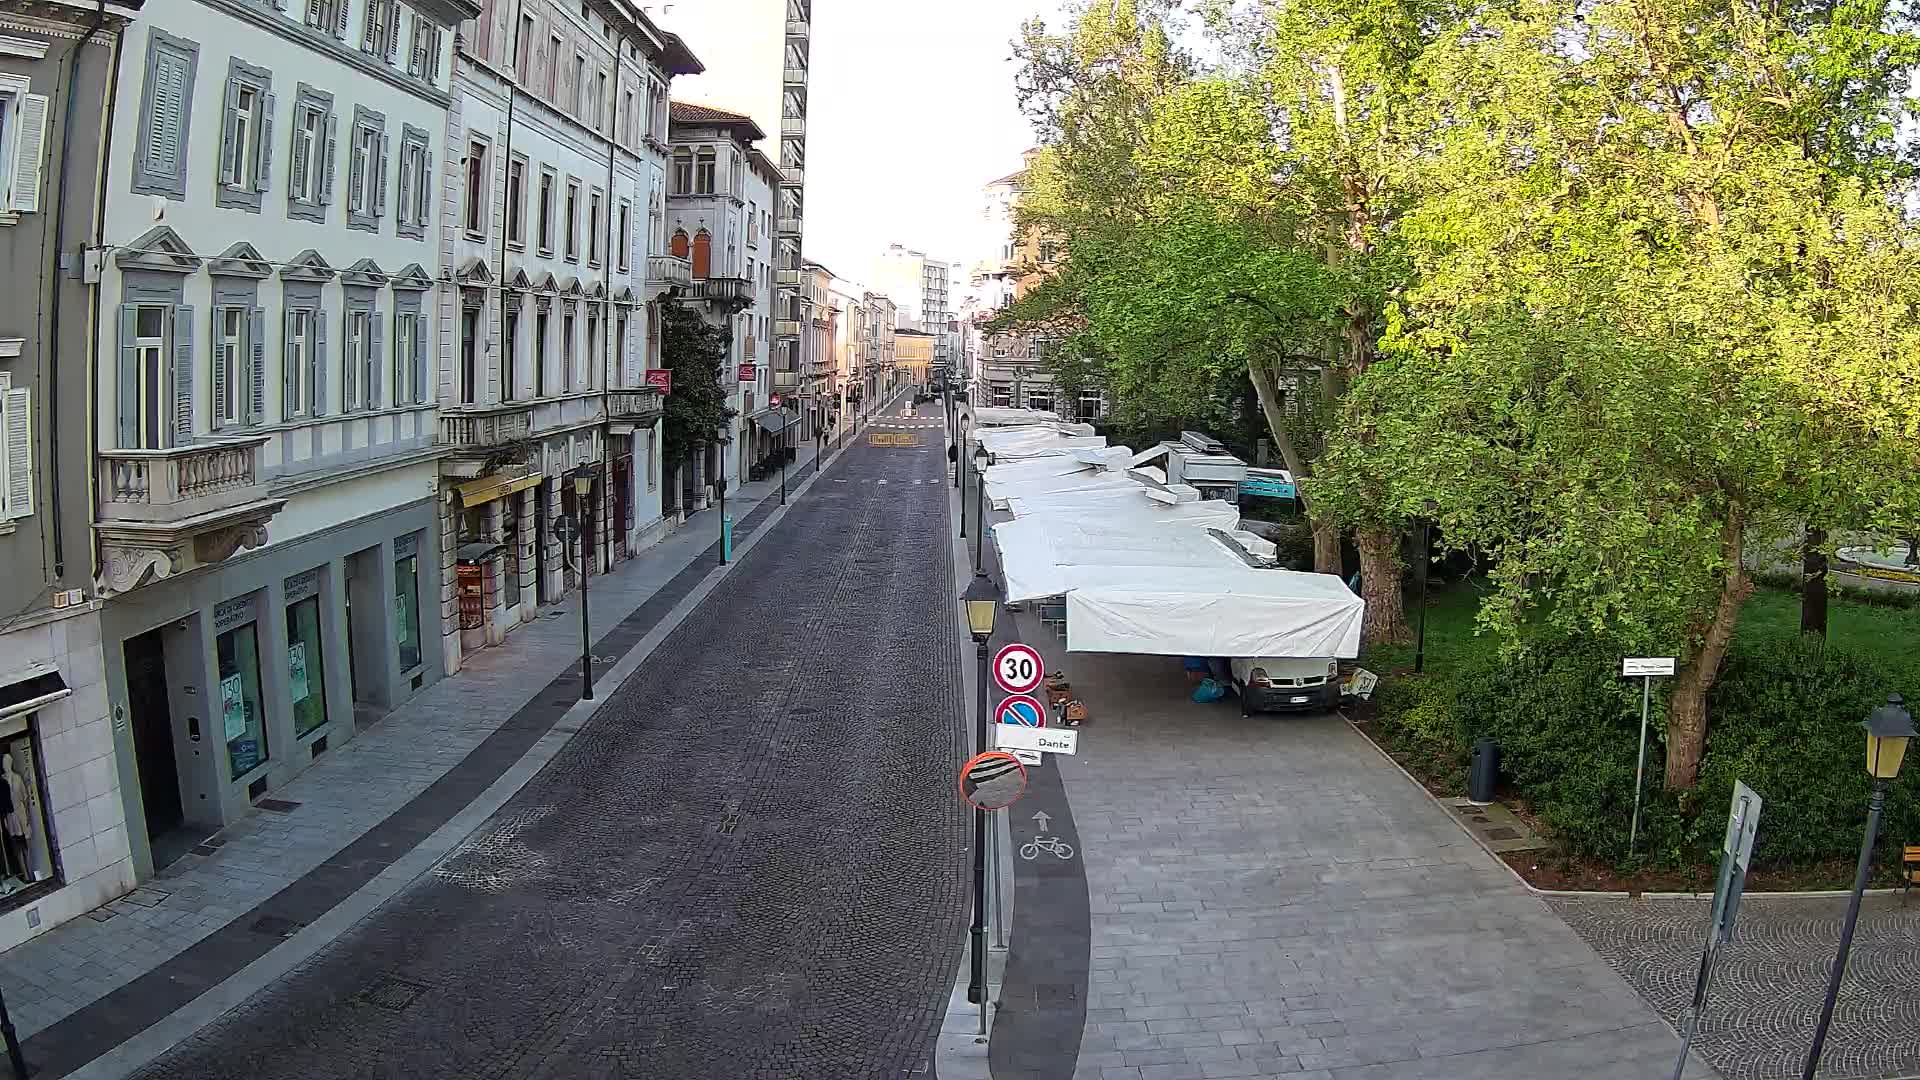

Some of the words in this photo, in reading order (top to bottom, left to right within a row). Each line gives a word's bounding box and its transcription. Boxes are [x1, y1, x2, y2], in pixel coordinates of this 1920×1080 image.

[288, 645, 304, 666] 130
[1005, 658, 1033, 679] 30
[222, 677, 241, 698] 130
[1038, 738, 1069, 749] Dante
